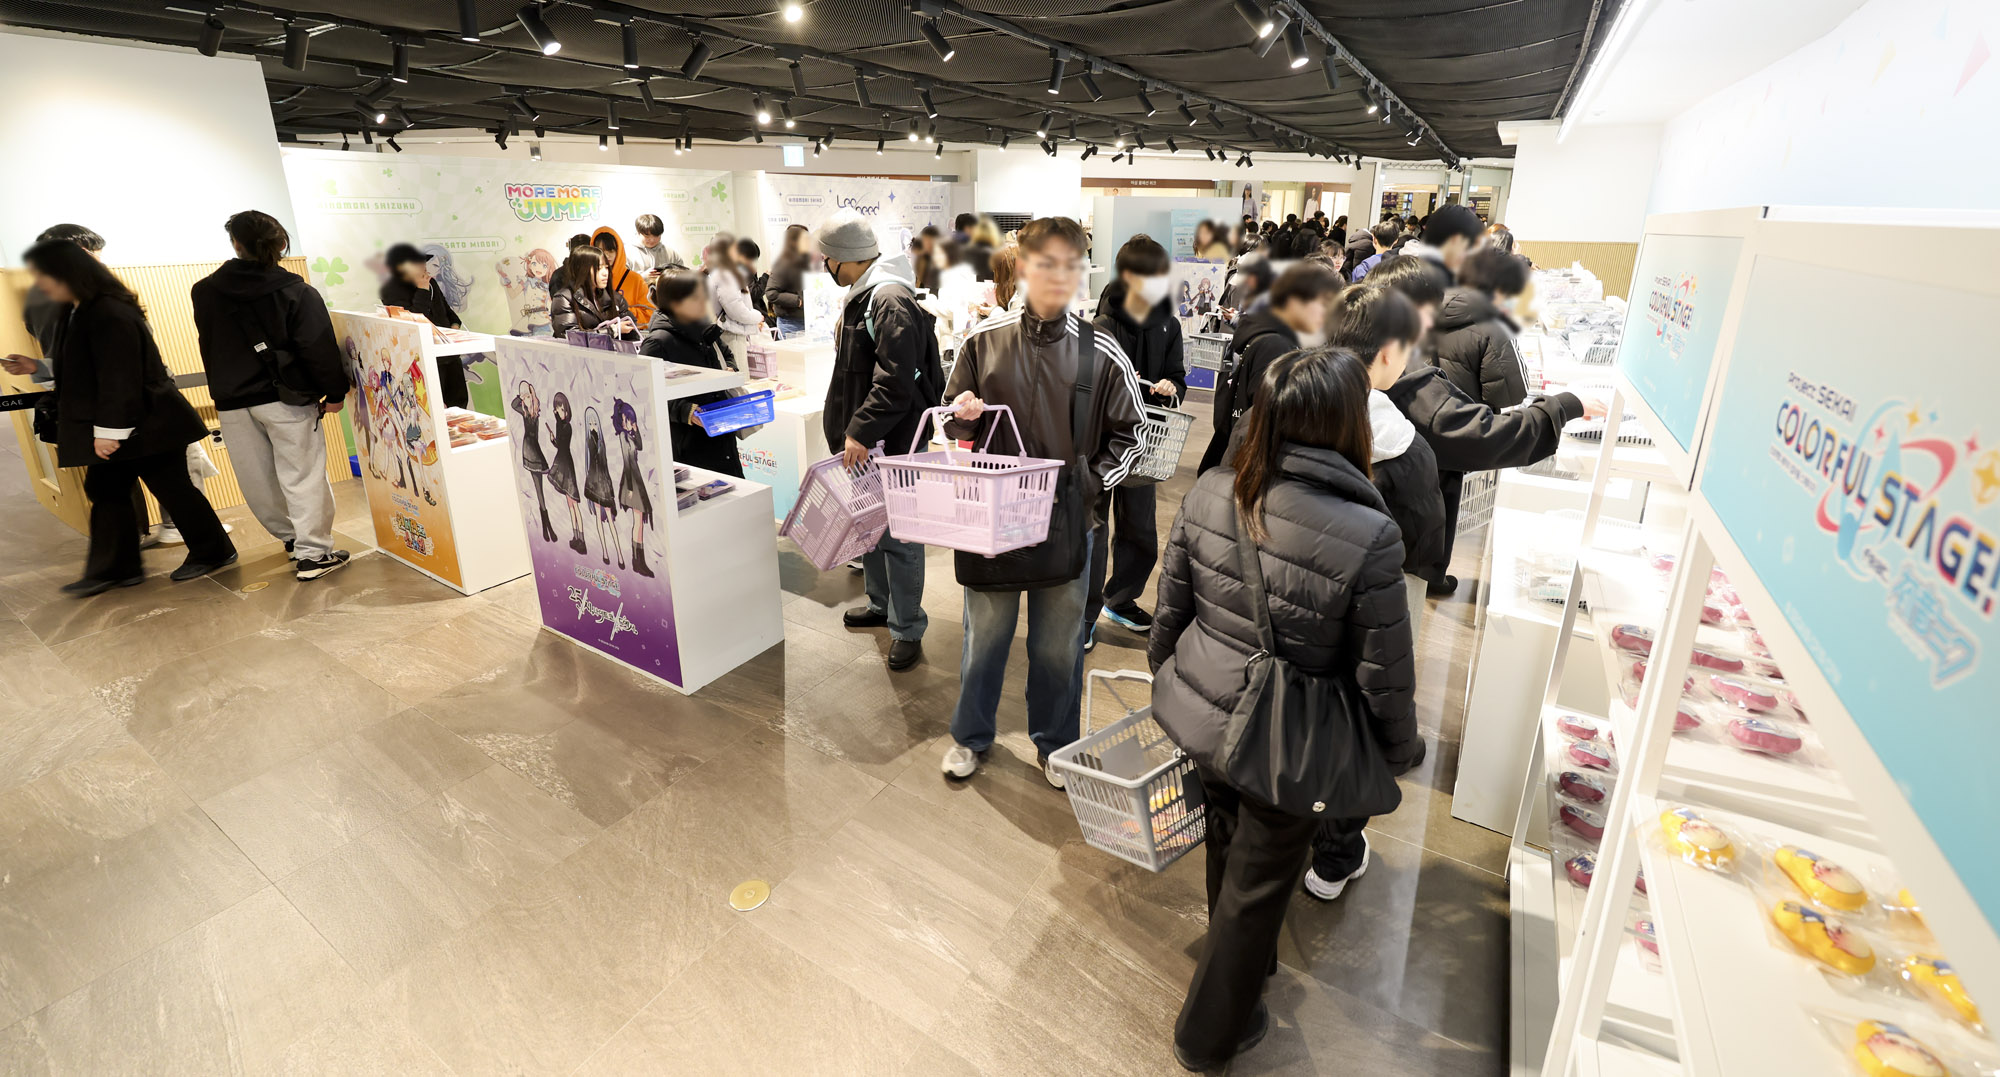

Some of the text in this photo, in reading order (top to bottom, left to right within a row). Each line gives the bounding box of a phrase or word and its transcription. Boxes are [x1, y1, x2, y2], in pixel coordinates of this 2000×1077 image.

[507, 186, 600, 198] MORE MORE
[374, 202, 415, 210] SHIZUKU
[516, 201, 598, 219] JUMP!
[1816, 385, 1856, 422] SEKAI
[738, 451, 753, 462] RFUL
[1776, 401, 1871, 507] COLORFUL
[1873, 471, 2000, 613] STAGE!
